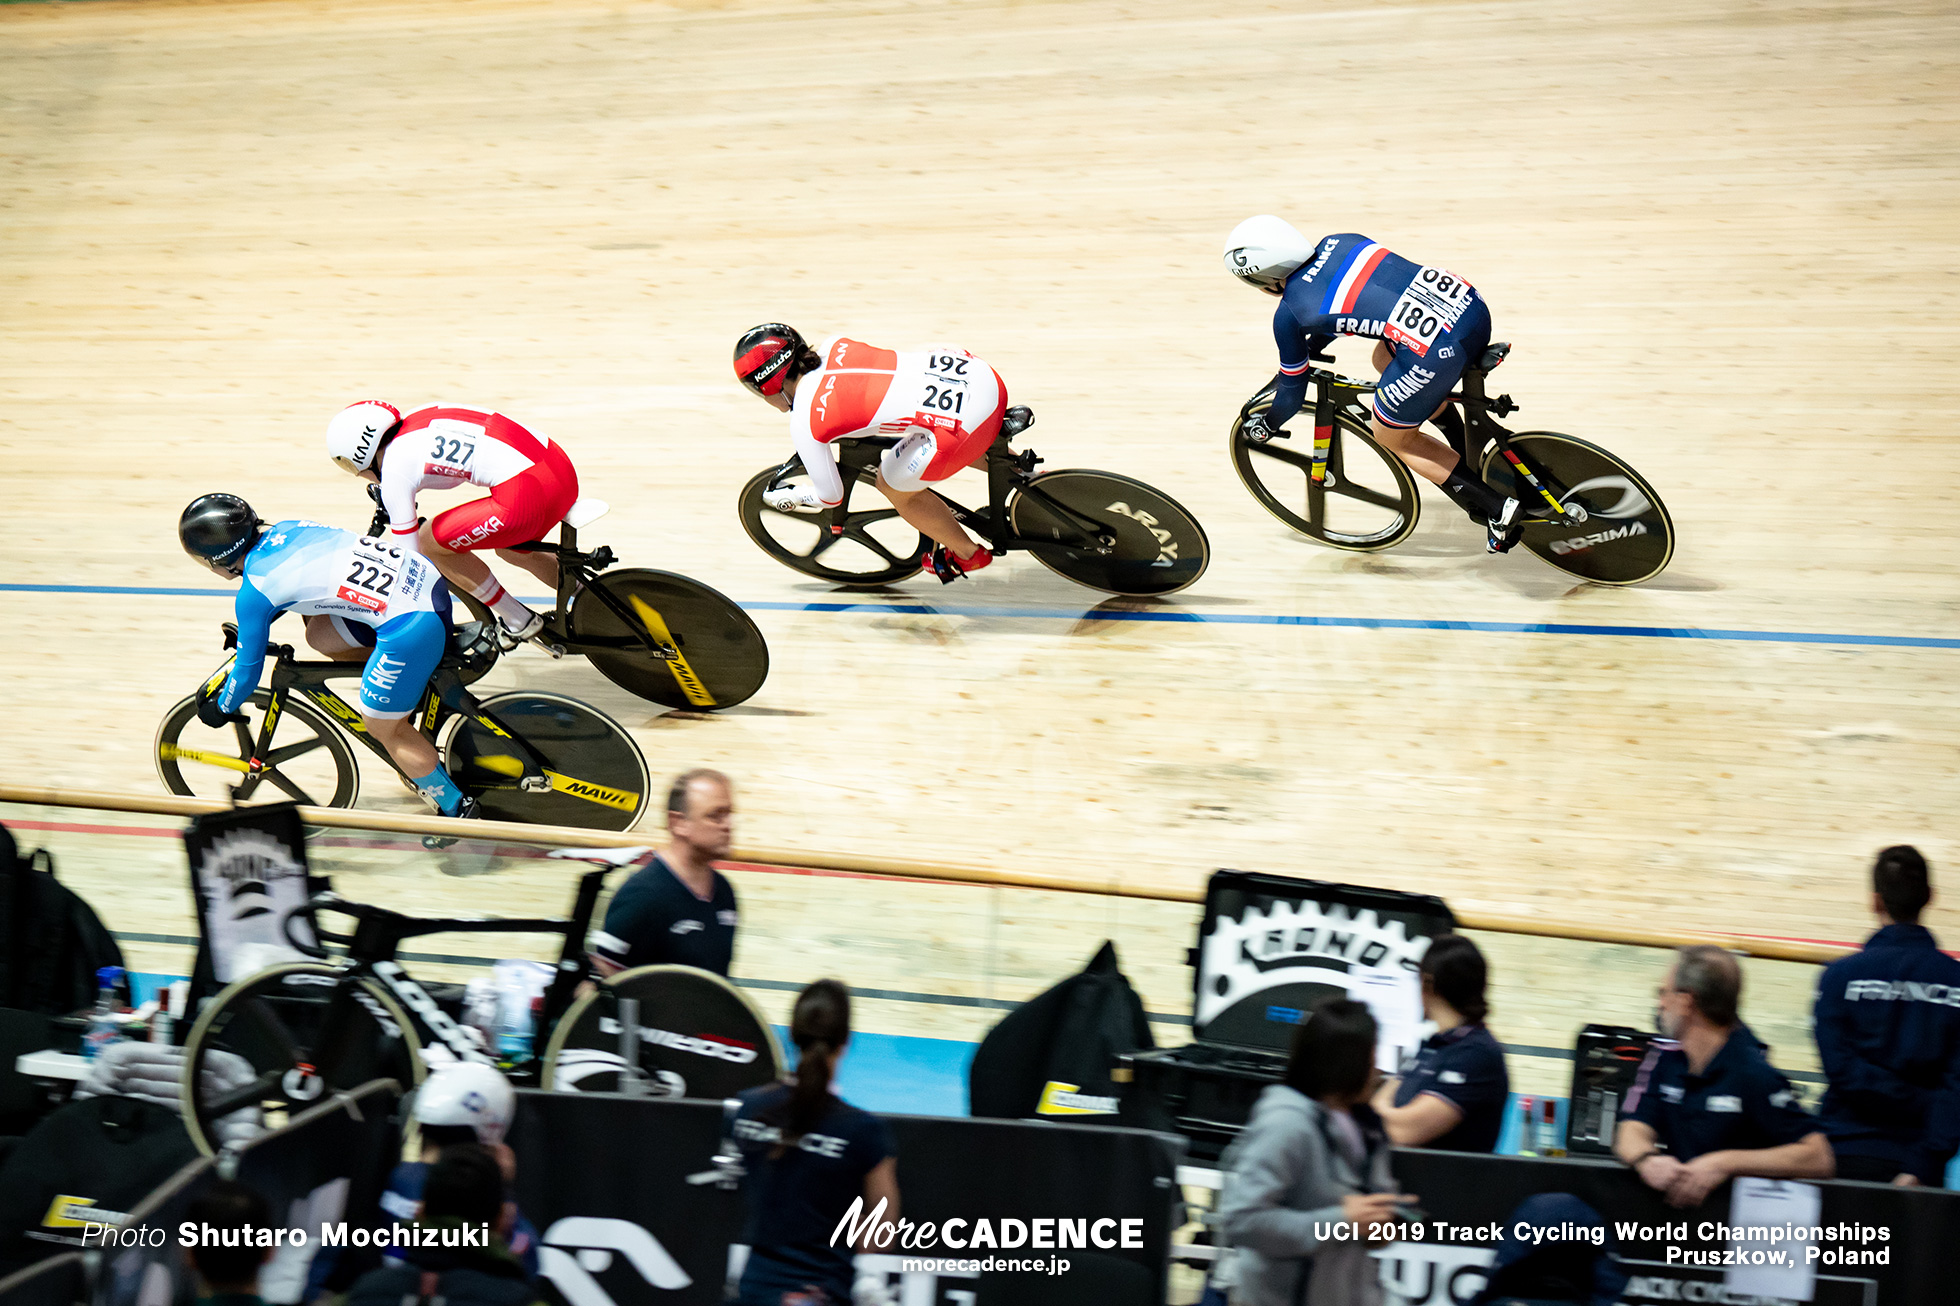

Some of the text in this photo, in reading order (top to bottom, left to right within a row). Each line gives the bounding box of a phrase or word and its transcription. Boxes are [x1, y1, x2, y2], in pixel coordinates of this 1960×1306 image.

[1231, 265, 1260, 276] GIRO
[1302, 238, 1340, 283] FRANCE
[1422, 268, 1463, 299] 180
[1335, 318, 1387, 337] FRAN
[1395, 301, 1438, 338] 180
[1445, 294, 1473, 328] FRANCE
[754, 349, 792, 383] Kabuto
[929, 354, 969, 375] 261
[922, 385, 964, 414] 261
[1383, 364, 1436, 407] FRANCE
[430, 435, 475, 466] 327
[448, 515, 505, 550] POLSKA
[1104, 501, 1178, 568] ARAYA
[346, 561, 394, 597] 222
[347, 605, 372, 615] System
[367, 653, 406, 690] HKT
[361, 683, 391, 704] HKG
[733, 1118, 850, 1158] FRACE
